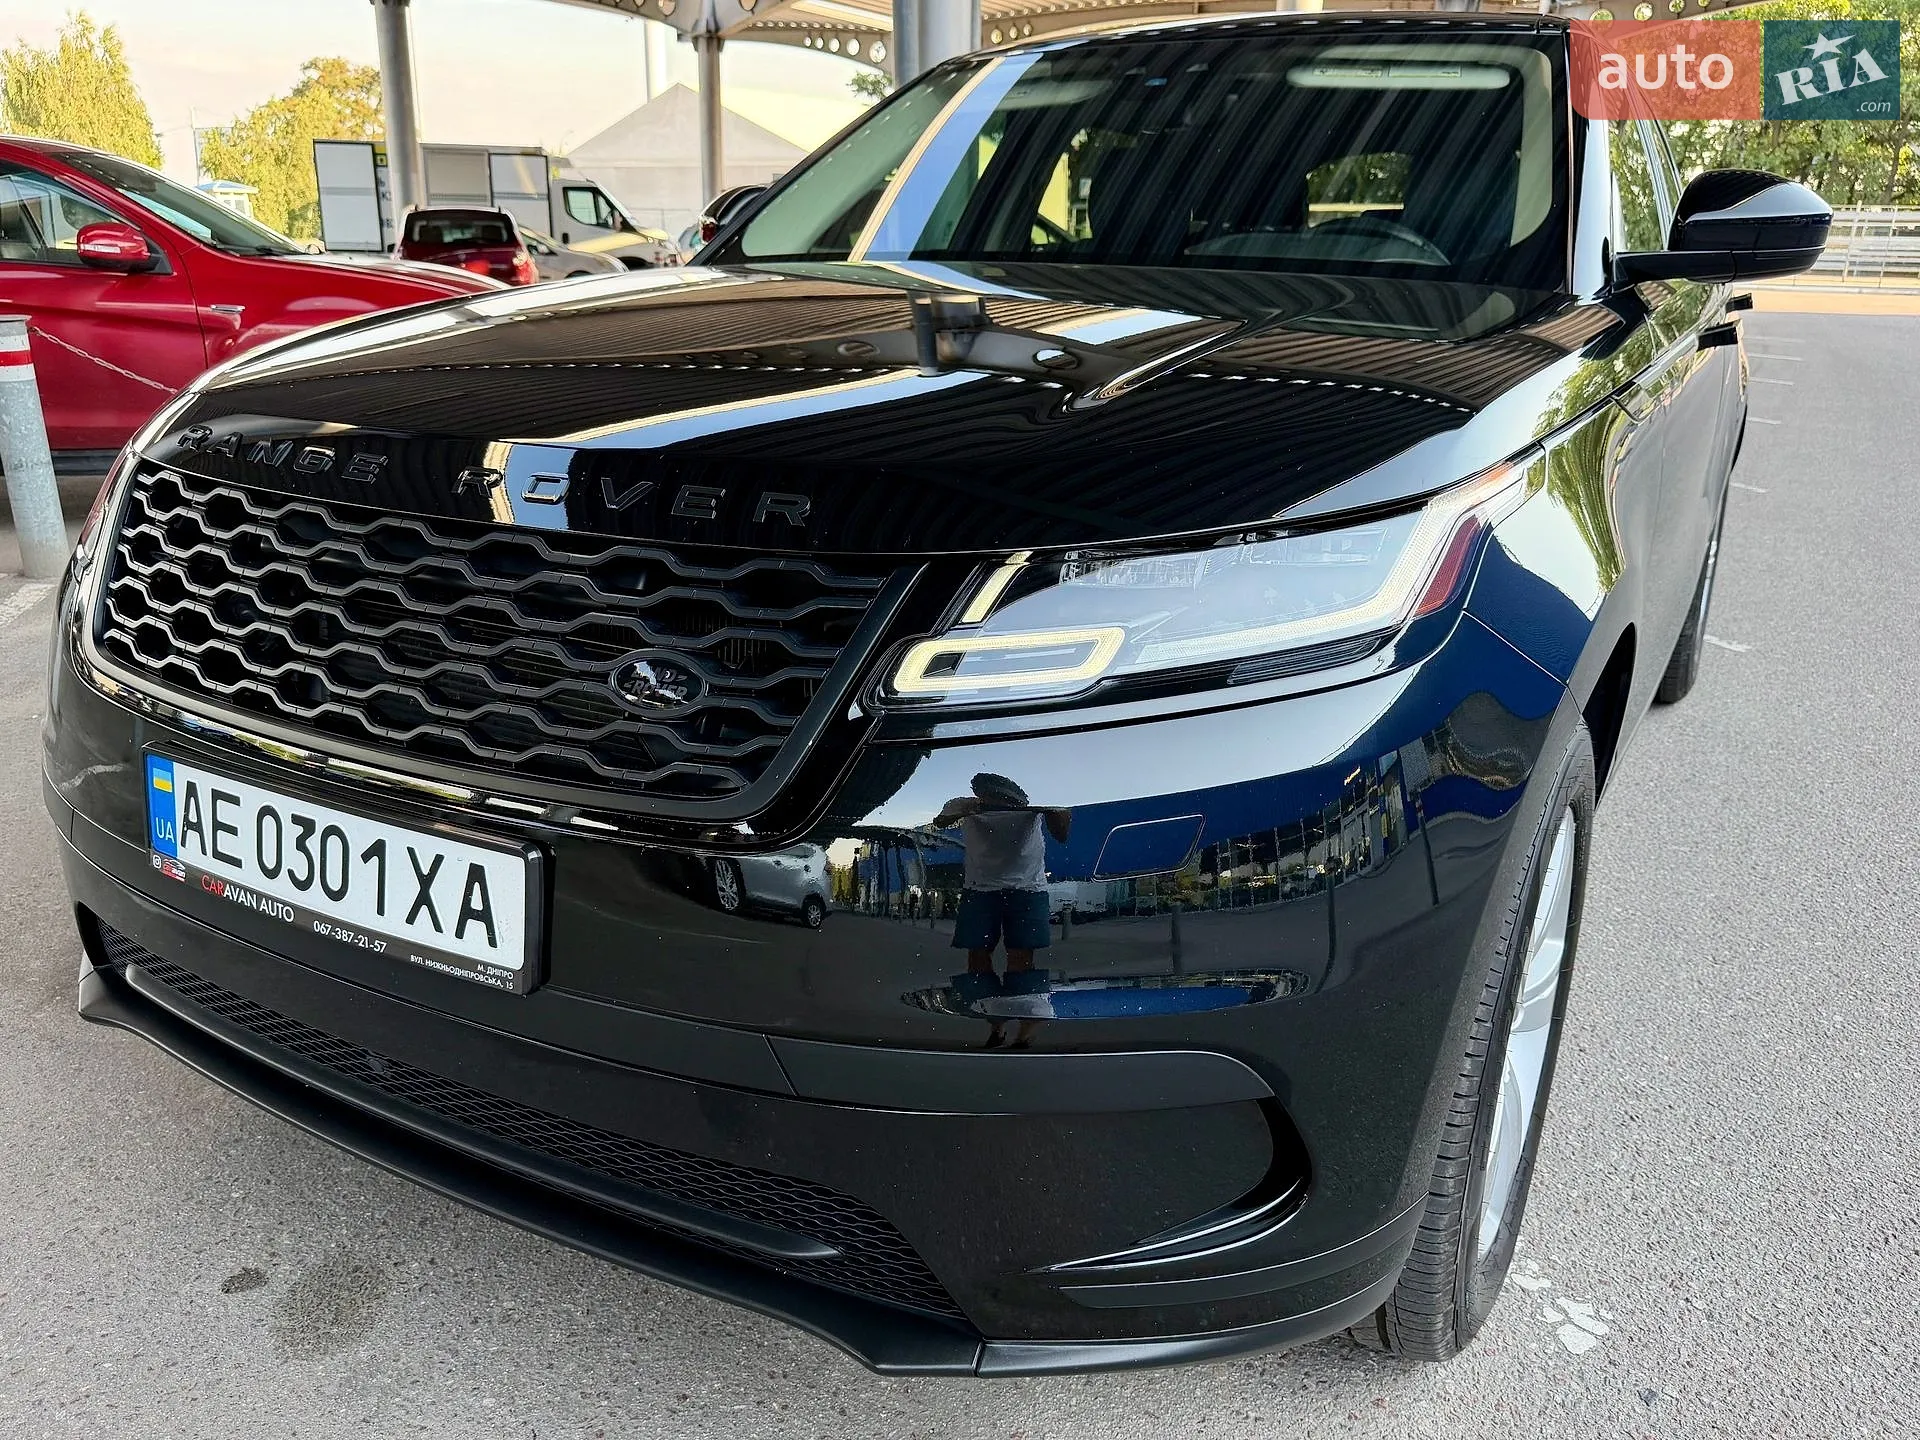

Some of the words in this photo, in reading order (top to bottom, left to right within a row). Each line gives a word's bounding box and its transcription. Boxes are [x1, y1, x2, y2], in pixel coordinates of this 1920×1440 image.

[176, 424, 389, 484] RANGE
[451, 465, 812, 527] ROVER
[156, 816, 175, 843] UA
[202, 874, 257, 911] CARAVAN
[259, 900, 295, 923] AUTO
[313, 920, 387, 953] 067-387-21-57
[505, 981, 514, 990] 15
